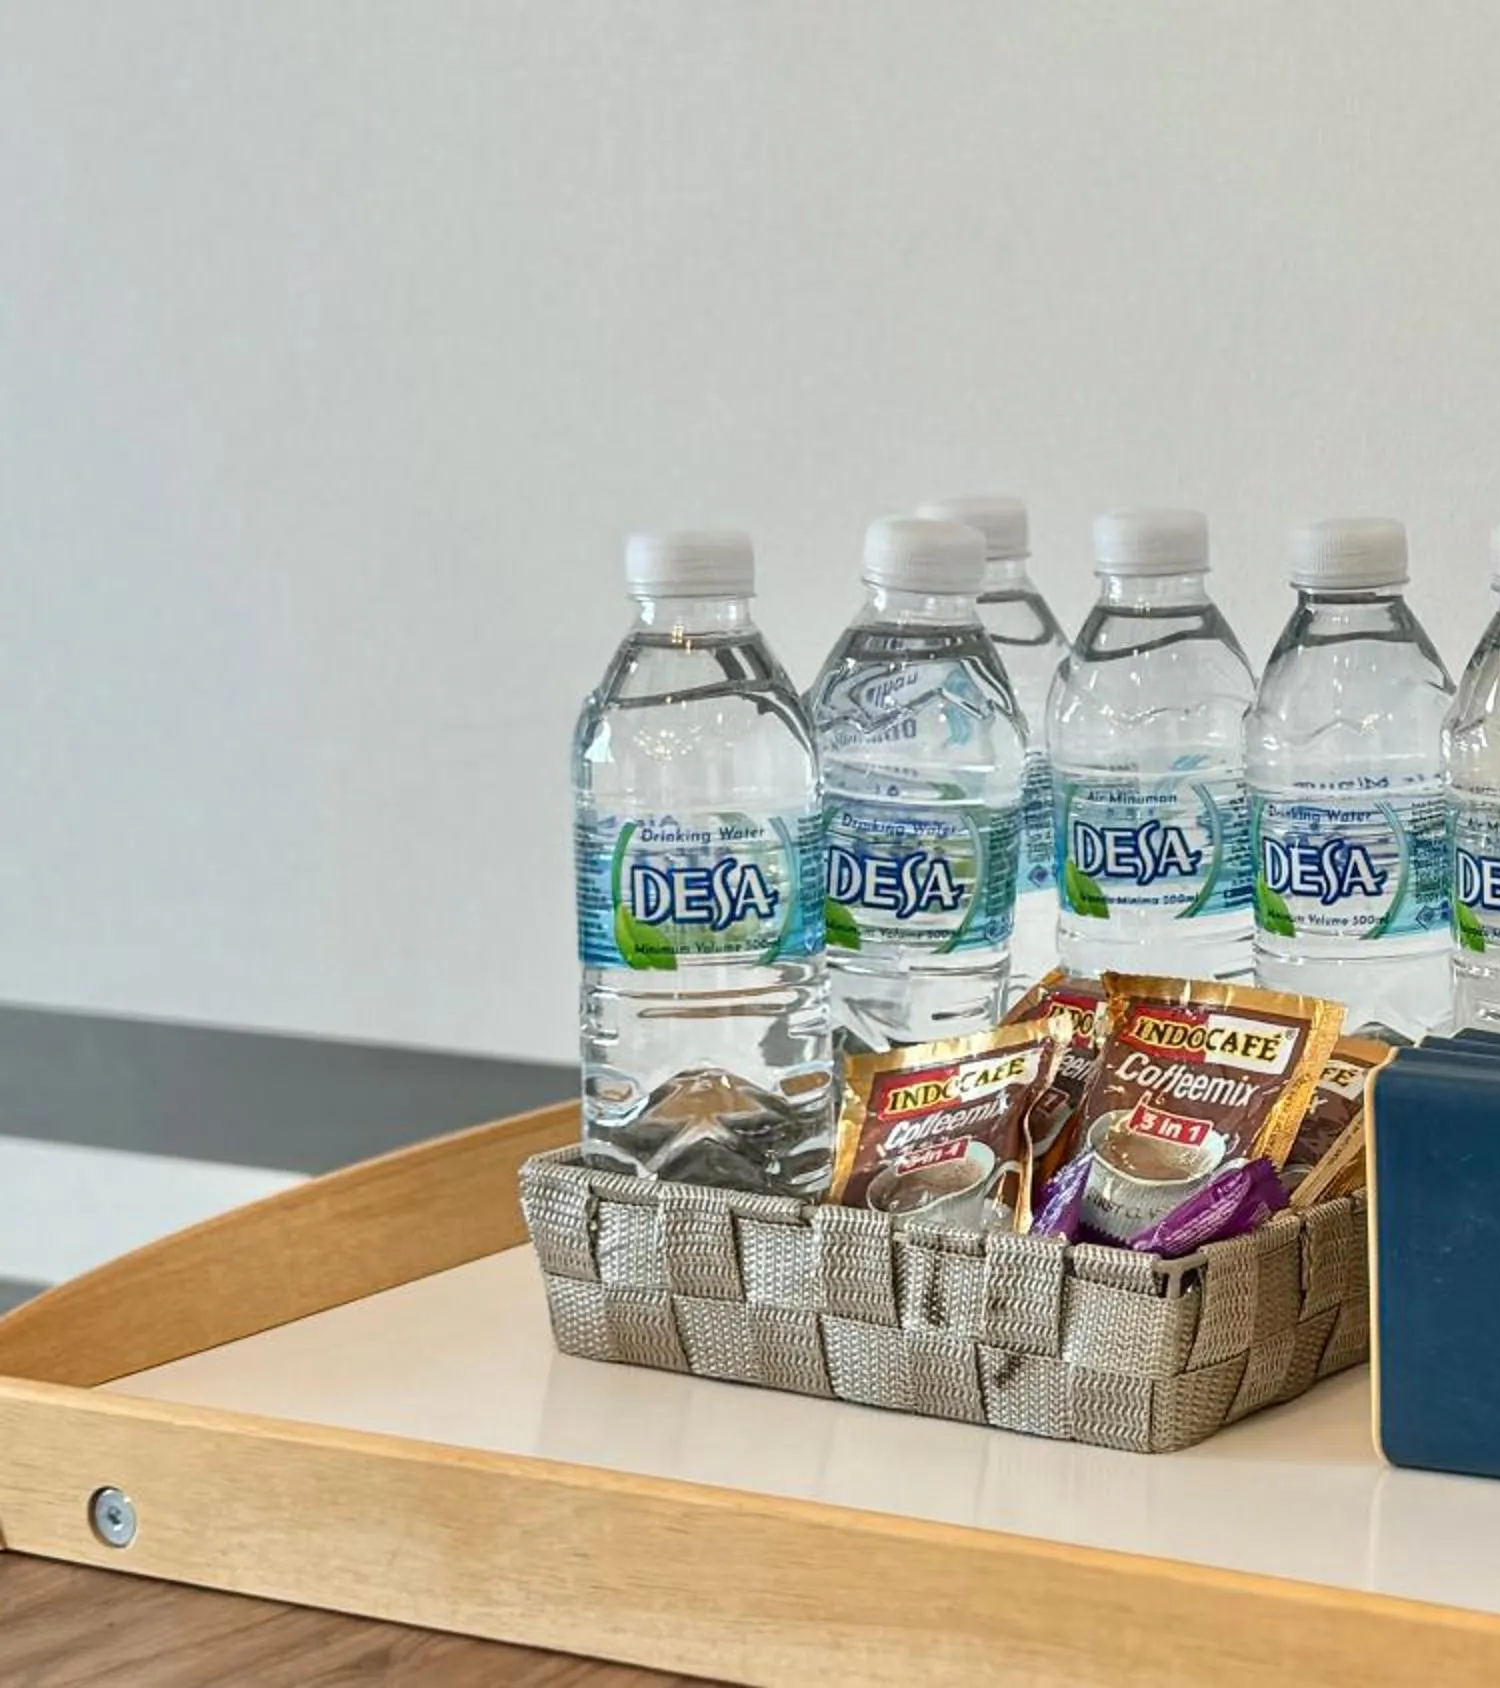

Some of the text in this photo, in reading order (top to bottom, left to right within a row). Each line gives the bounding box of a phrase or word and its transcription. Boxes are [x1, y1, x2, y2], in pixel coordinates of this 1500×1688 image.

[640, 825, 767, 845] Drinking Water
[1326, 808, 1373, 822] Water
[828, 845, 964, 920] DESA
[1073, 819, 1203, 886] DESA
[1262, 836, 1388, 907] DESA
[630, 857, 780, 933] DESA
[1114, 1052, 1261, 1108] Coffeemix
[1140, 1111, 1155, 1130] 3
[1187, 1123, 1201, 1142] 1
